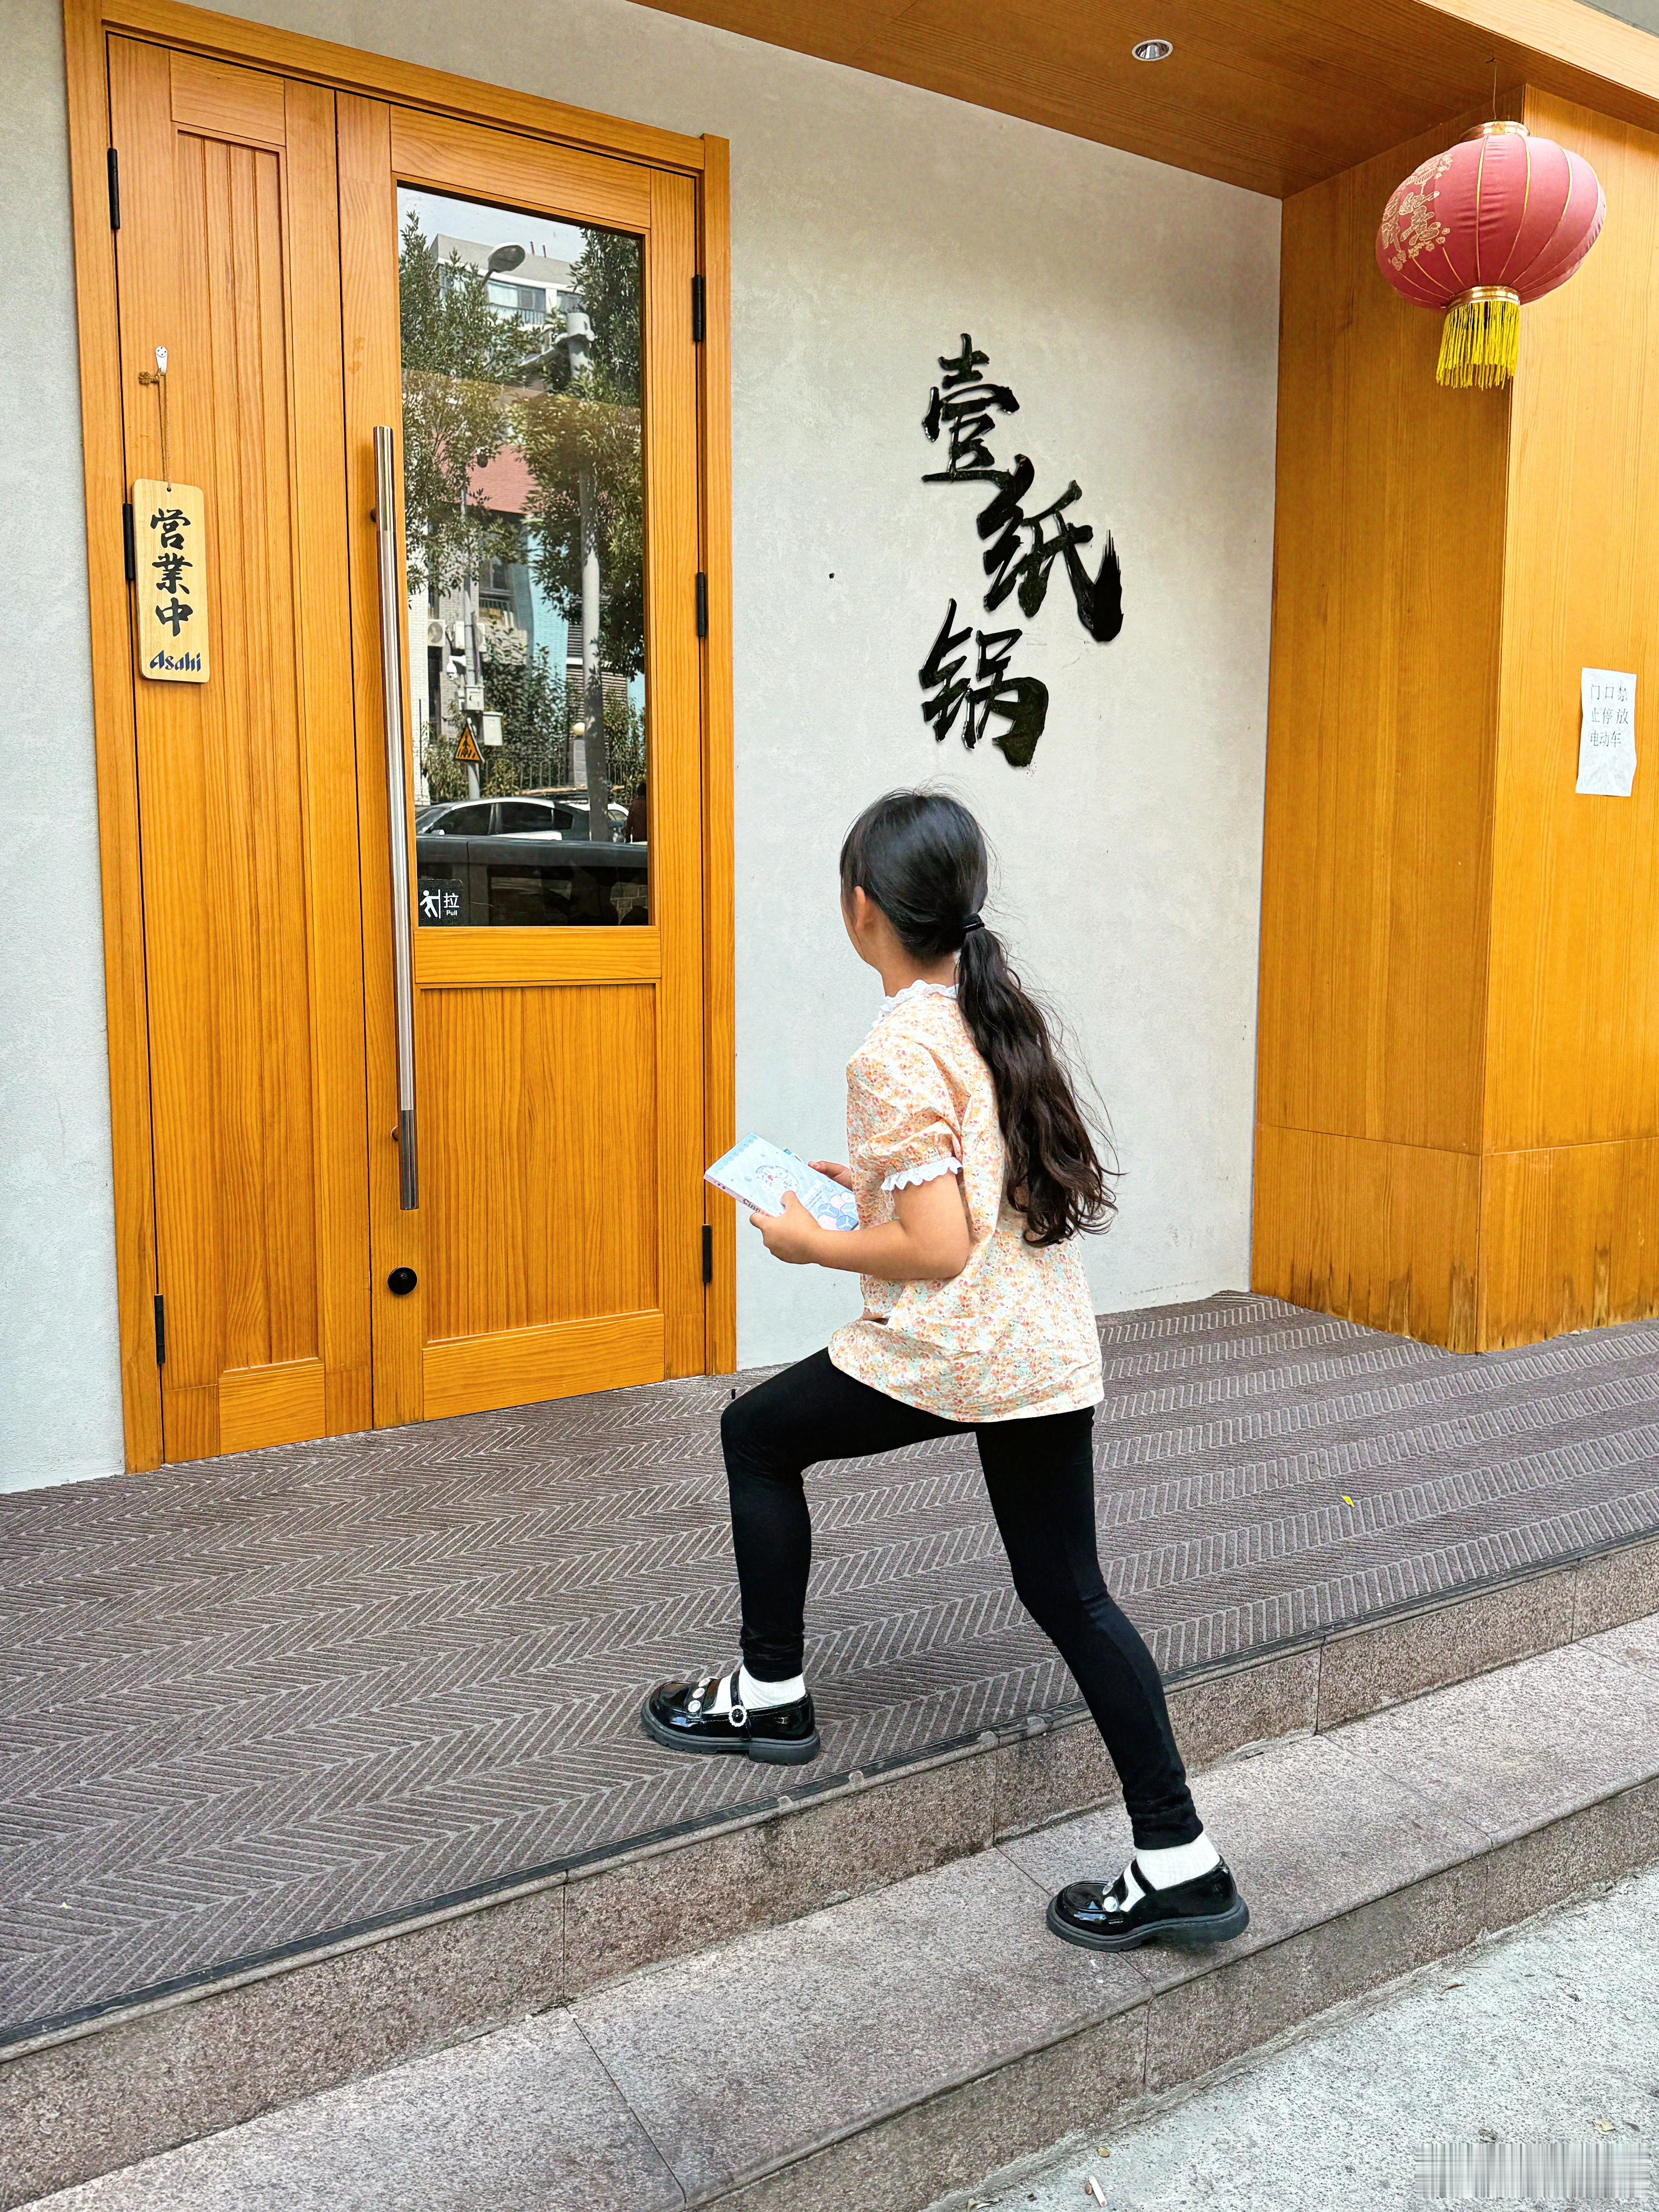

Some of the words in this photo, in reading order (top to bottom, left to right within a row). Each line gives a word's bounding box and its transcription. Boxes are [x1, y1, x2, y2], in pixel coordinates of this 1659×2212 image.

[920, 332, 1124, 768] 壹纸锅
[149, 649, 201, 672] Asahi
[1590, 684, 1628, 701] 门口禁
[1591, 707, 1629, 725] 止停放
[1590, 729, 1621, 748] 电动车
[443, 892, 460, 908] 拉
